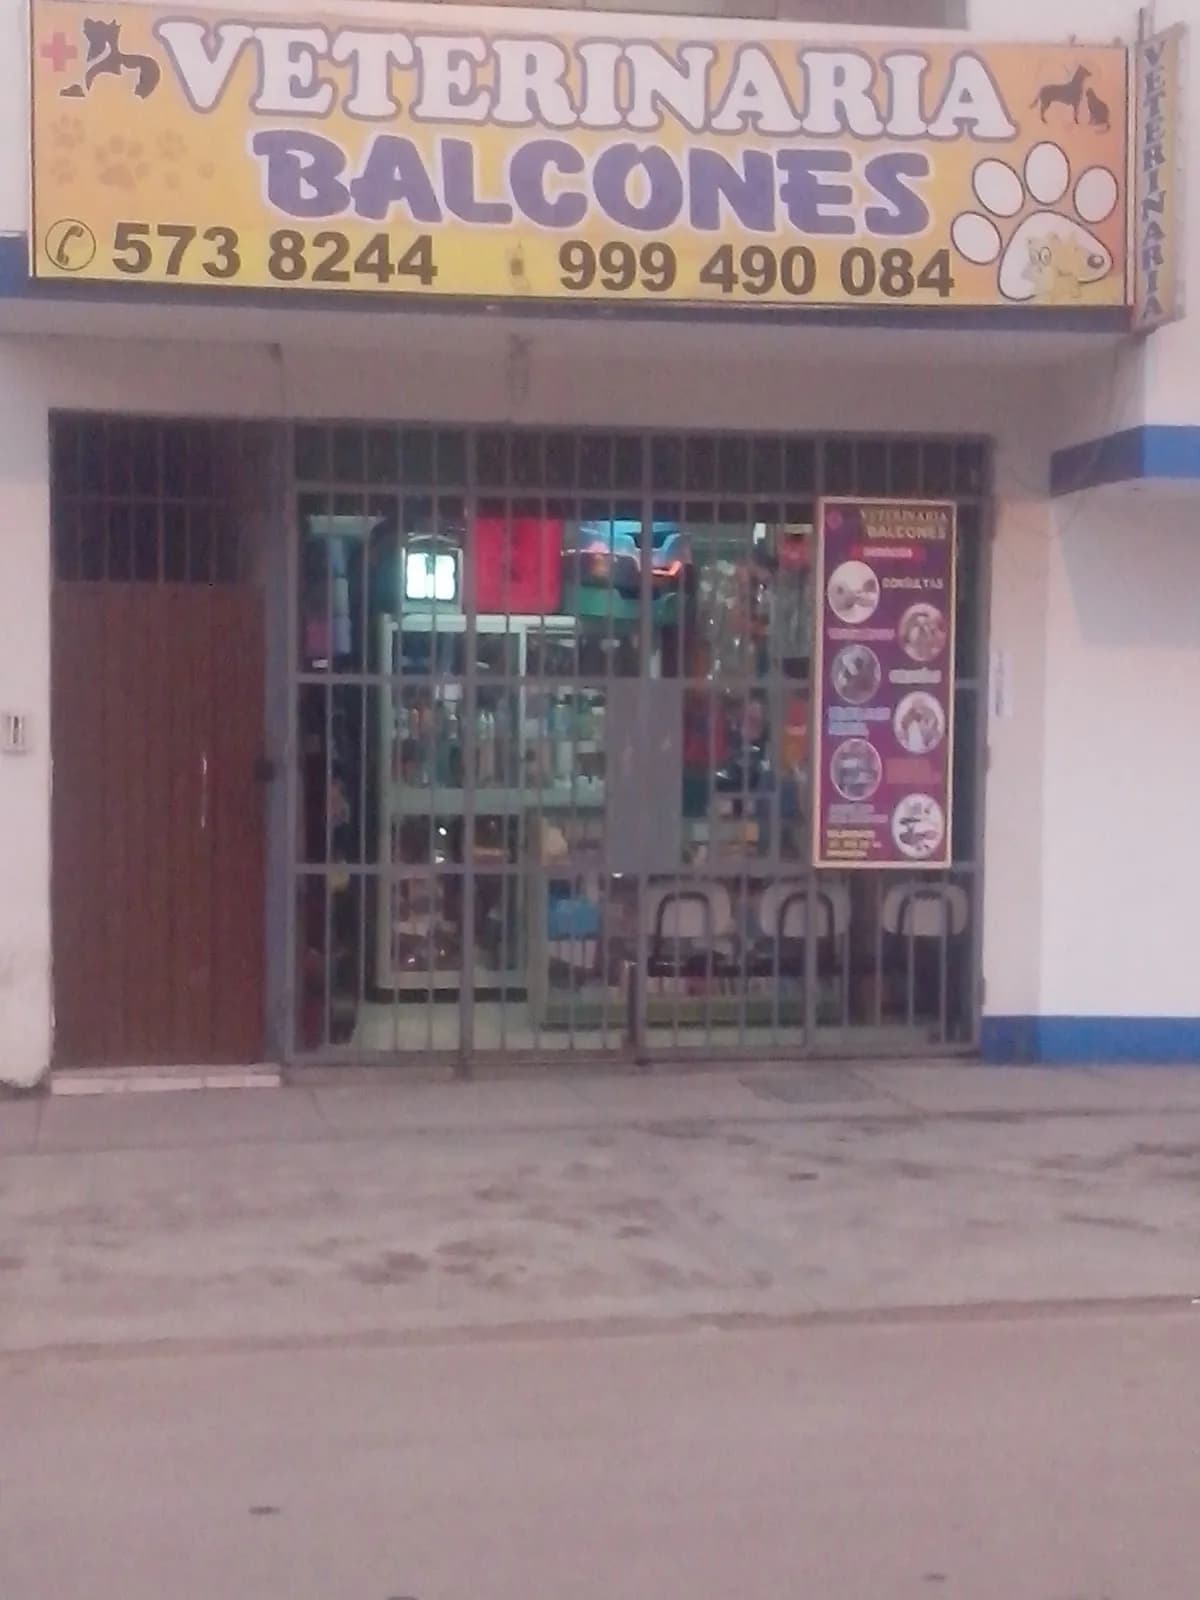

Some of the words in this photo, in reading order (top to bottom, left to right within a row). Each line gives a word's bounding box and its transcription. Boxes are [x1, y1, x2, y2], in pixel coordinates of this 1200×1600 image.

[154, 16, 1020, 141] VETERINARIA
[252, 129, 930, 234] BALCONES
[1140, 42, 1166, 319] VETERINARIA
[112, 223, 241, 276] 573
[268, 230, 438, 285] 8244
[559, 240, 677, 292] 999
[700, 244, 816, 296] 490
[840, 247, 955, 298] 084
